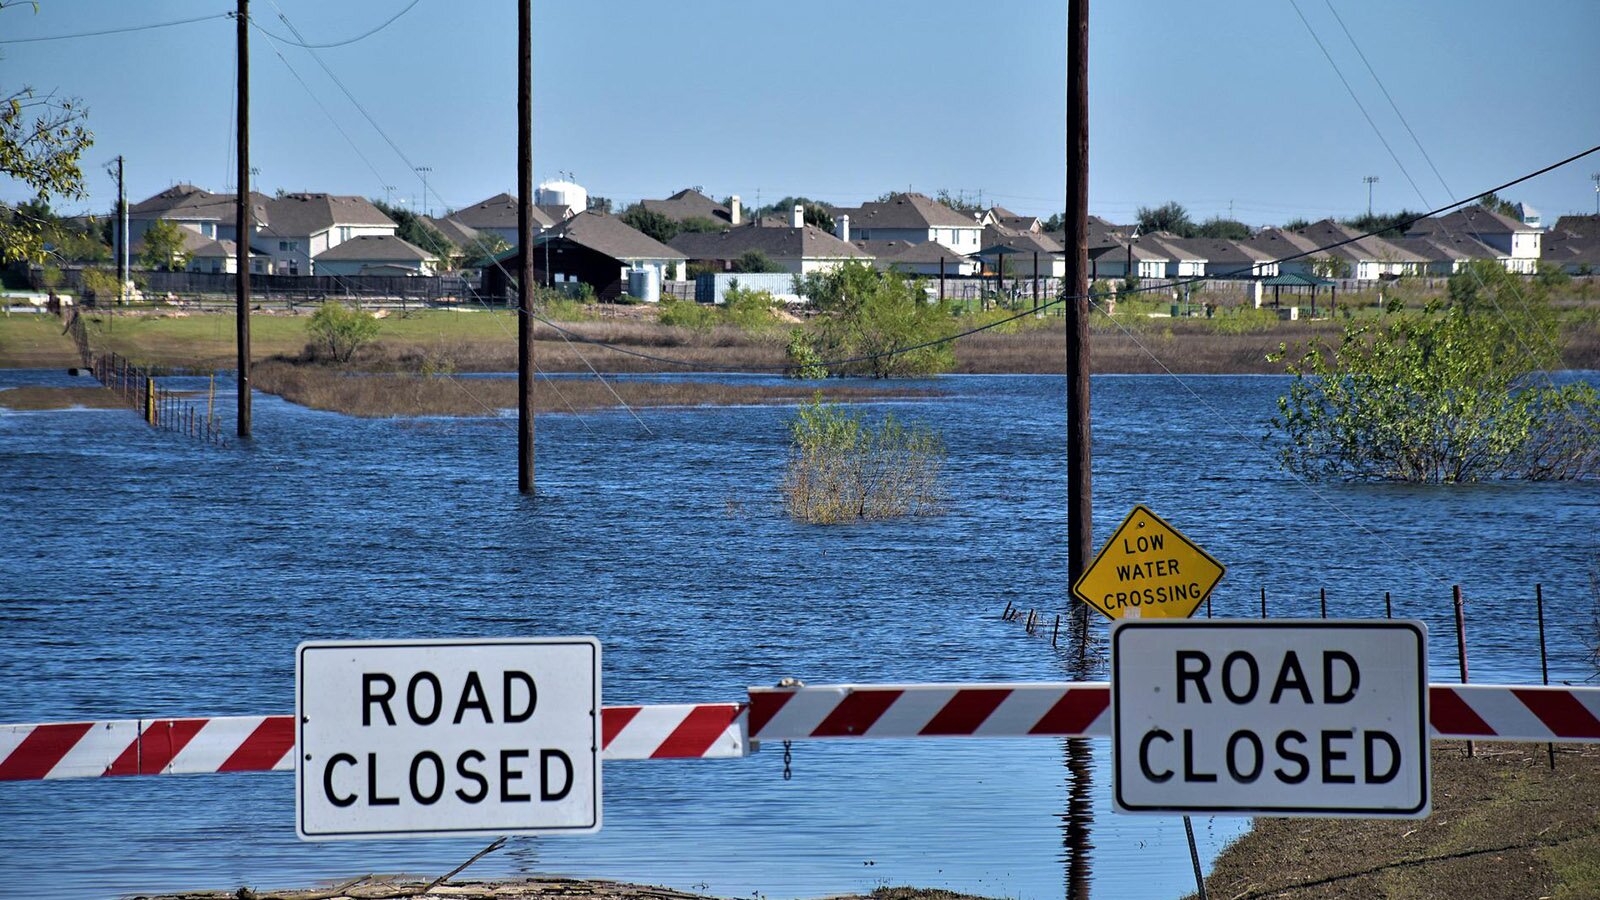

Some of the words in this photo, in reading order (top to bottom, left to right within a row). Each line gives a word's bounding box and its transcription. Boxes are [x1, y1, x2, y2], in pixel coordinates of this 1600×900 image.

[1117, 559, 1179, 582] WATER
[1124, 534, 1163, 554] LOW
[1104, 583, 1200, 610] CROSSING
[362, 670, 537, 727] ROAD
[1176, 650, 1360, 706] ROAD
[324, 749, 573, 807] CLOSED
[1139, 727, 1401, 785] CLOSED
